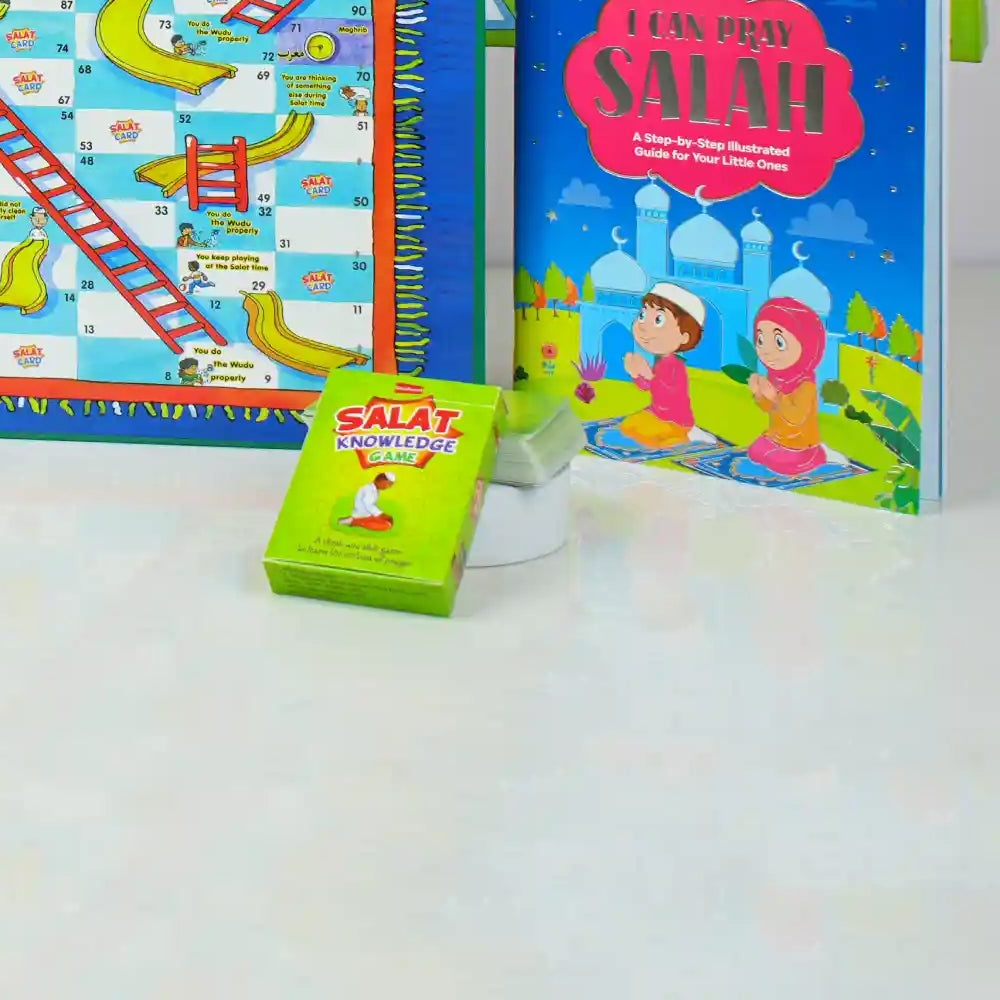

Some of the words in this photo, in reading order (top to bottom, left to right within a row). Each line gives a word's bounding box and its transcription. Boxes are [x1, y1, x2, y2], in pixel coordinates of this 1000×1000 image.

[60, 0, 73, 10] 87
[351, 5, 367, 17] 90
[338, 25, 368, 34] Maghrib
[628, 8, 637, 37] I
[648, 10, 704, 41] CAN
[717, 15, 794, 52] PRAY
[56, 43, 69, 53] 74
[262, 51, 275, 62] 72
[78, 64, 92, 74] 68
[13, 74, 43, 86] SALAT
[281, 74, 294, 82] You
[307, 74, 337, 83] thinking
[356, 71, 371, 82] 70
[17, 83, 42, 93] CARD
[286, 82, 294, 90] of
[294, 83, 332, 91] something
[592, 45, 826, 135] SALAH
[57, 95, 71, 105] 67
[304, 92, 327, 100] during
[178, 114, 192, 124] 52
[357, 121, 368, 131] 51
[632, 132, 642, 142] A
[644, 132, 726, 151] Step-by-Step
[727, 141, 791, 157] Illustrated
[634, 146, 670, 160] Guide
[672, 150, 690, 162] for
[692, 152, 721, 165] Your
[722, 155, 755, 169] Little
[756, 159, 789, 172] Ones
[301, 177, 332, 188] SALAT
[306, 186, 331, 195] CARD
[353, 196, 369, 207] 50
[258, 206, 273, 217] 32
[279, 238, 291, 249] 31
[210, 254, 230, 262] keep
[231, 254, 260, 263] playing
[230, 263, 250, 271] Salat
[250, 264, 270, 272] time
[352, 261, 367, 271] 30
[81, 279, 95, 290] 28
[252, 280, 266, 291] 29
[210, 299, 221, 310] 12
[353, 304, 362, 315] 11
[84, 324, 95, 335] 13
[193, 347, 209, 355] You
[210, 347, 222, 355] do
[212, 360, 228, 369] the
[229, 361, 254, 369] Wudu
[164, 371, 172, 381] 8
[210, 374, 246, 383] properly
[264, 374, 272, 384] 9
[336, 406, 460, 433] SALAT
[336, 434, 457, 453] KNOWLEDGE
[368, 451, 418, 463] GAME
